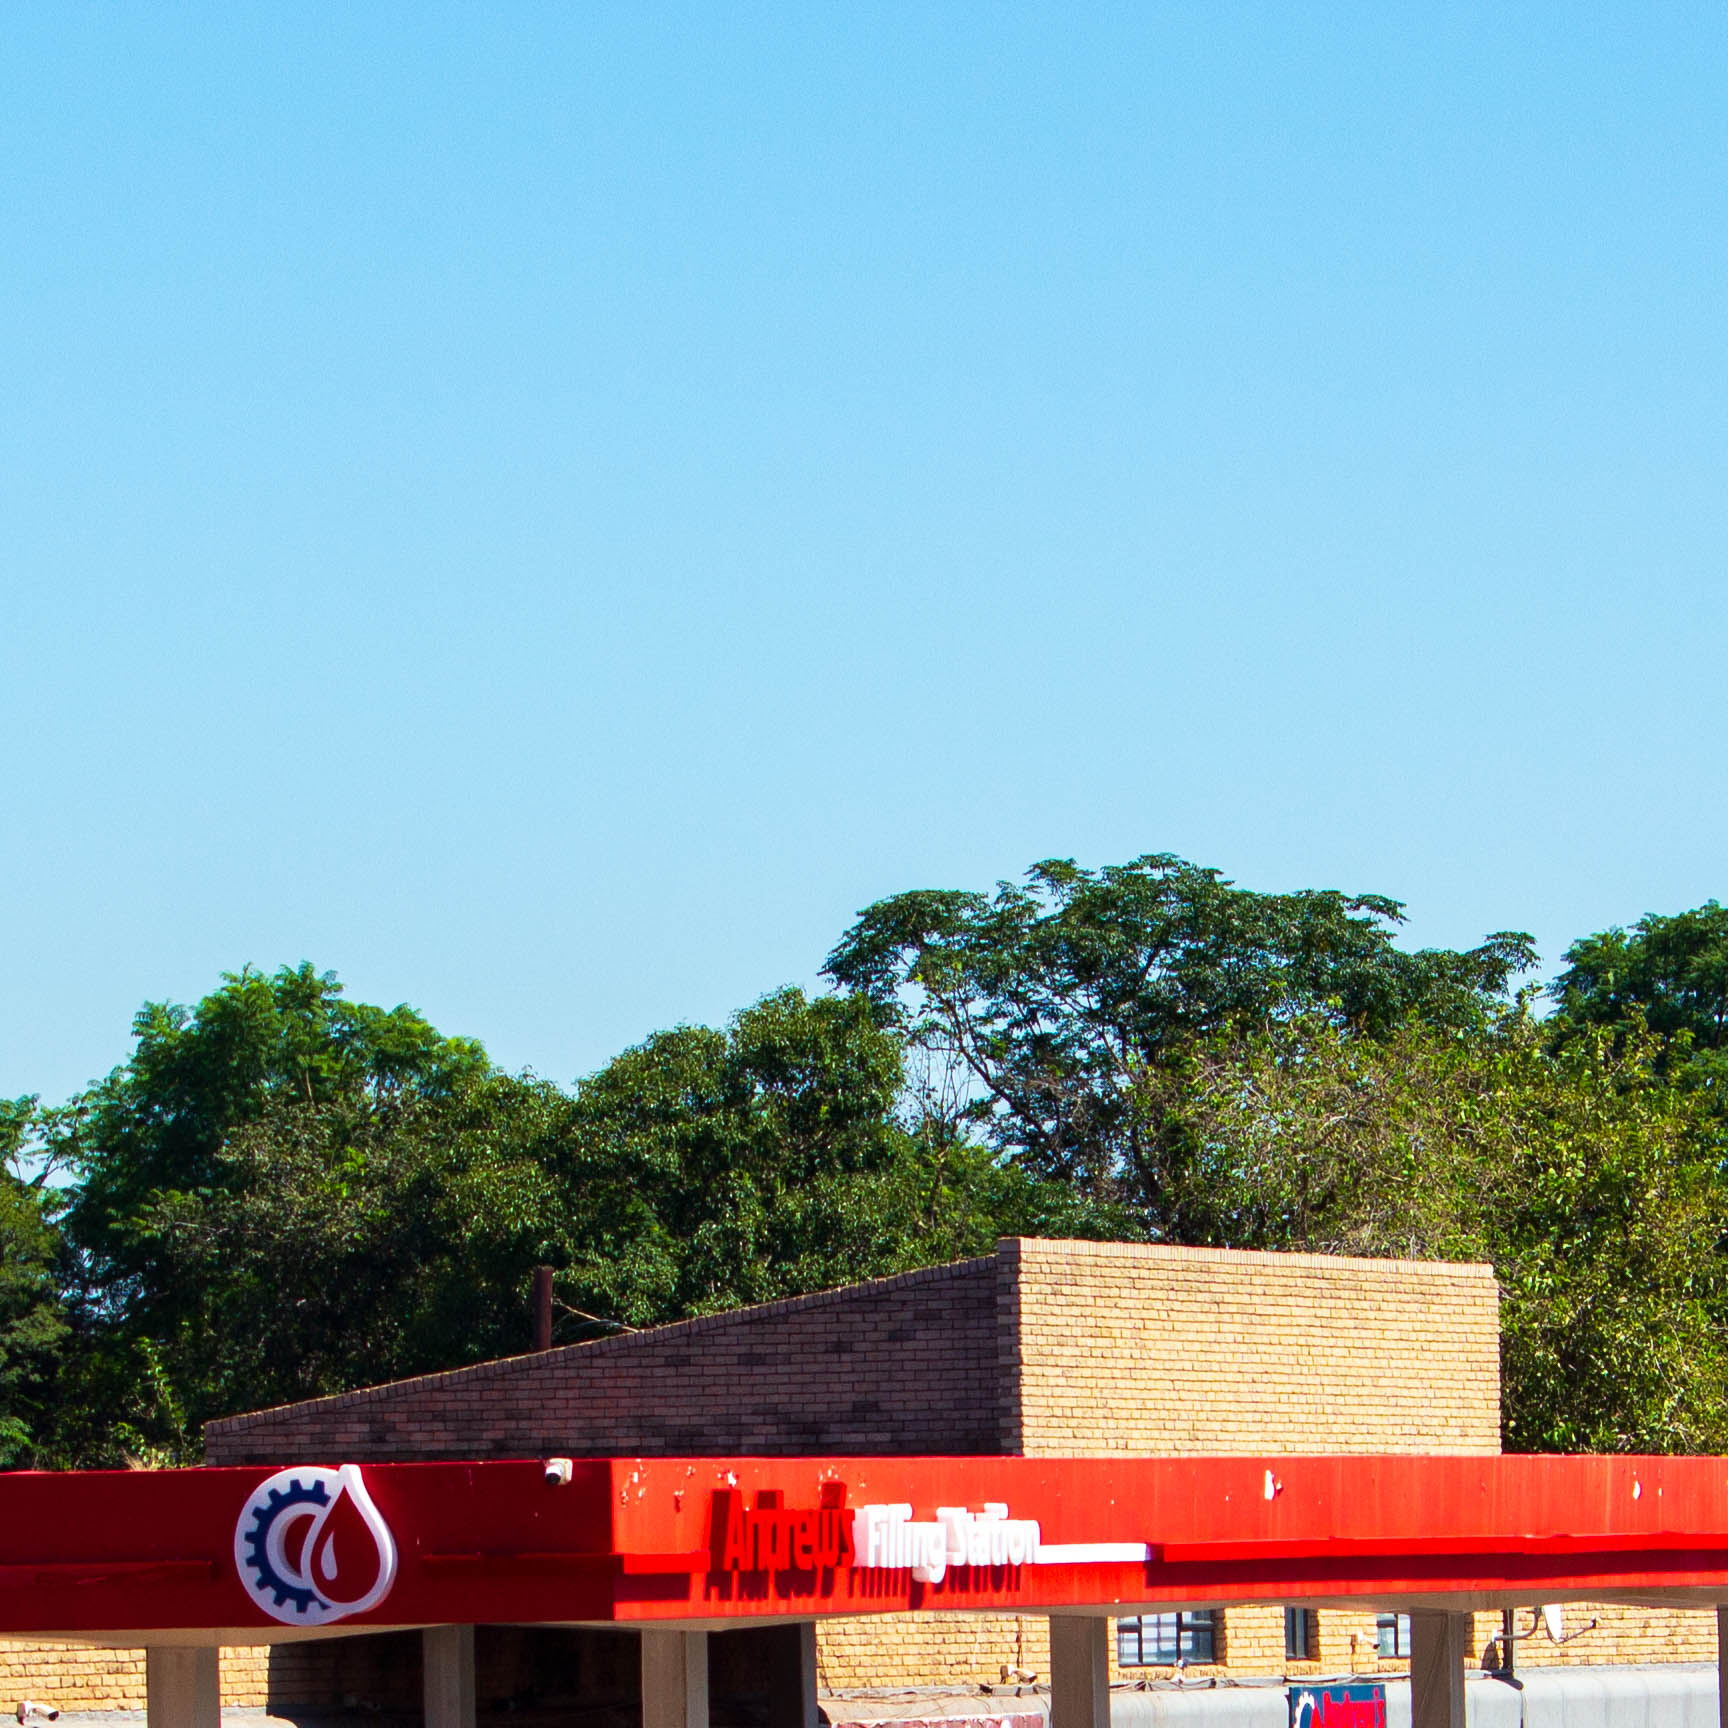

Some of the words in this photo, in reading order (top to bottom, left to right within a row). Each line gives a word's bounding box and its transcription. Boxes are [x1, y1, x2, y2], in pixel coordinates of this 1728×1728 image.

[710, 1482, 856, 1568] Andrew's
[855, 1503, 947, 1583] Filling
[938, 1503, 1040, 1567] Station
